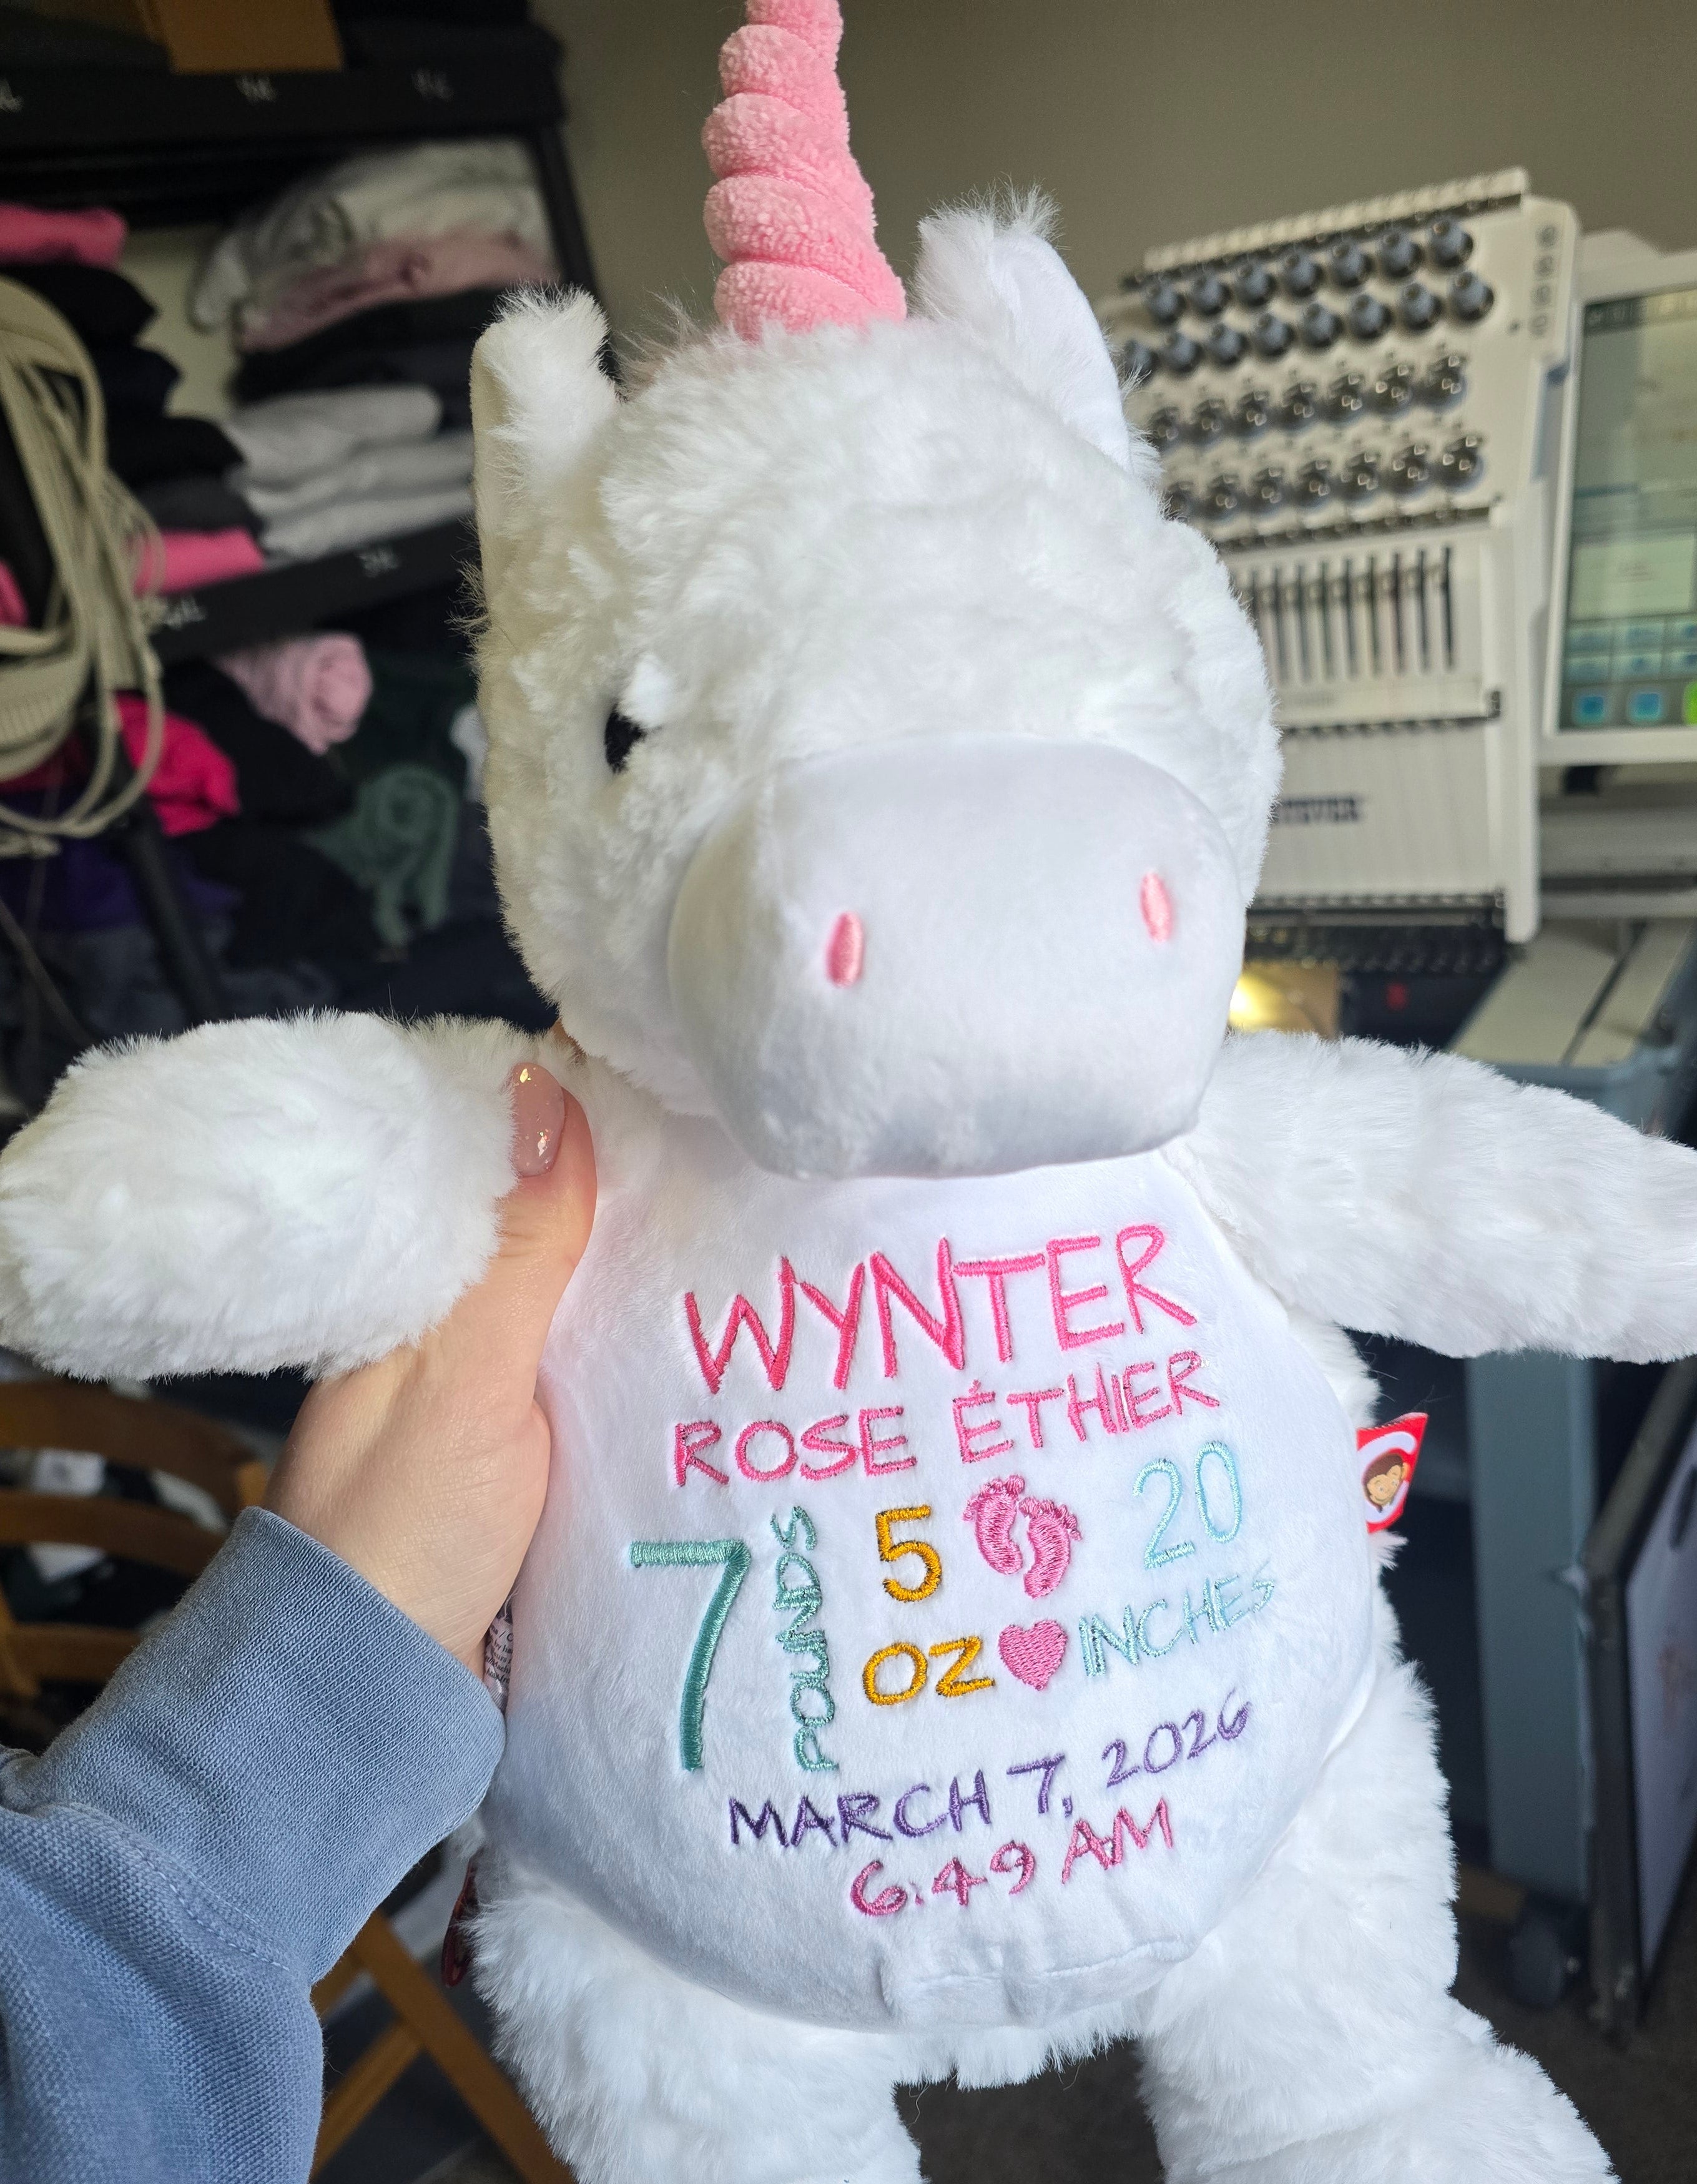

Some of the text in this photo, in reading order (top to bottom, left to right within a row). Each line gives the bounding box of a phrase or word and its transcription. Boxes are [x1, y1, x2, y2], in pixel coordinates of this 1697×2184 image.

[684, 1224, 1196, 1394] WYNTER
[674, 1351, 1219, 1486] ROSE ÉTHIER
[875, 1505, 942, 1602] 5
[1133, 1440, 1243, 1570] 20
[629, 1540, 749, 1772] 7
[770, 1506, 839, 1772] POUNDS
[863, 1636, 995, 1706] OZ
[1079, 1561, 1275, 1677] INCHES
[729, 1687, 1252, 1848] MARCH 7, 2026
[1061, 1798, 1173, 1884] AM
